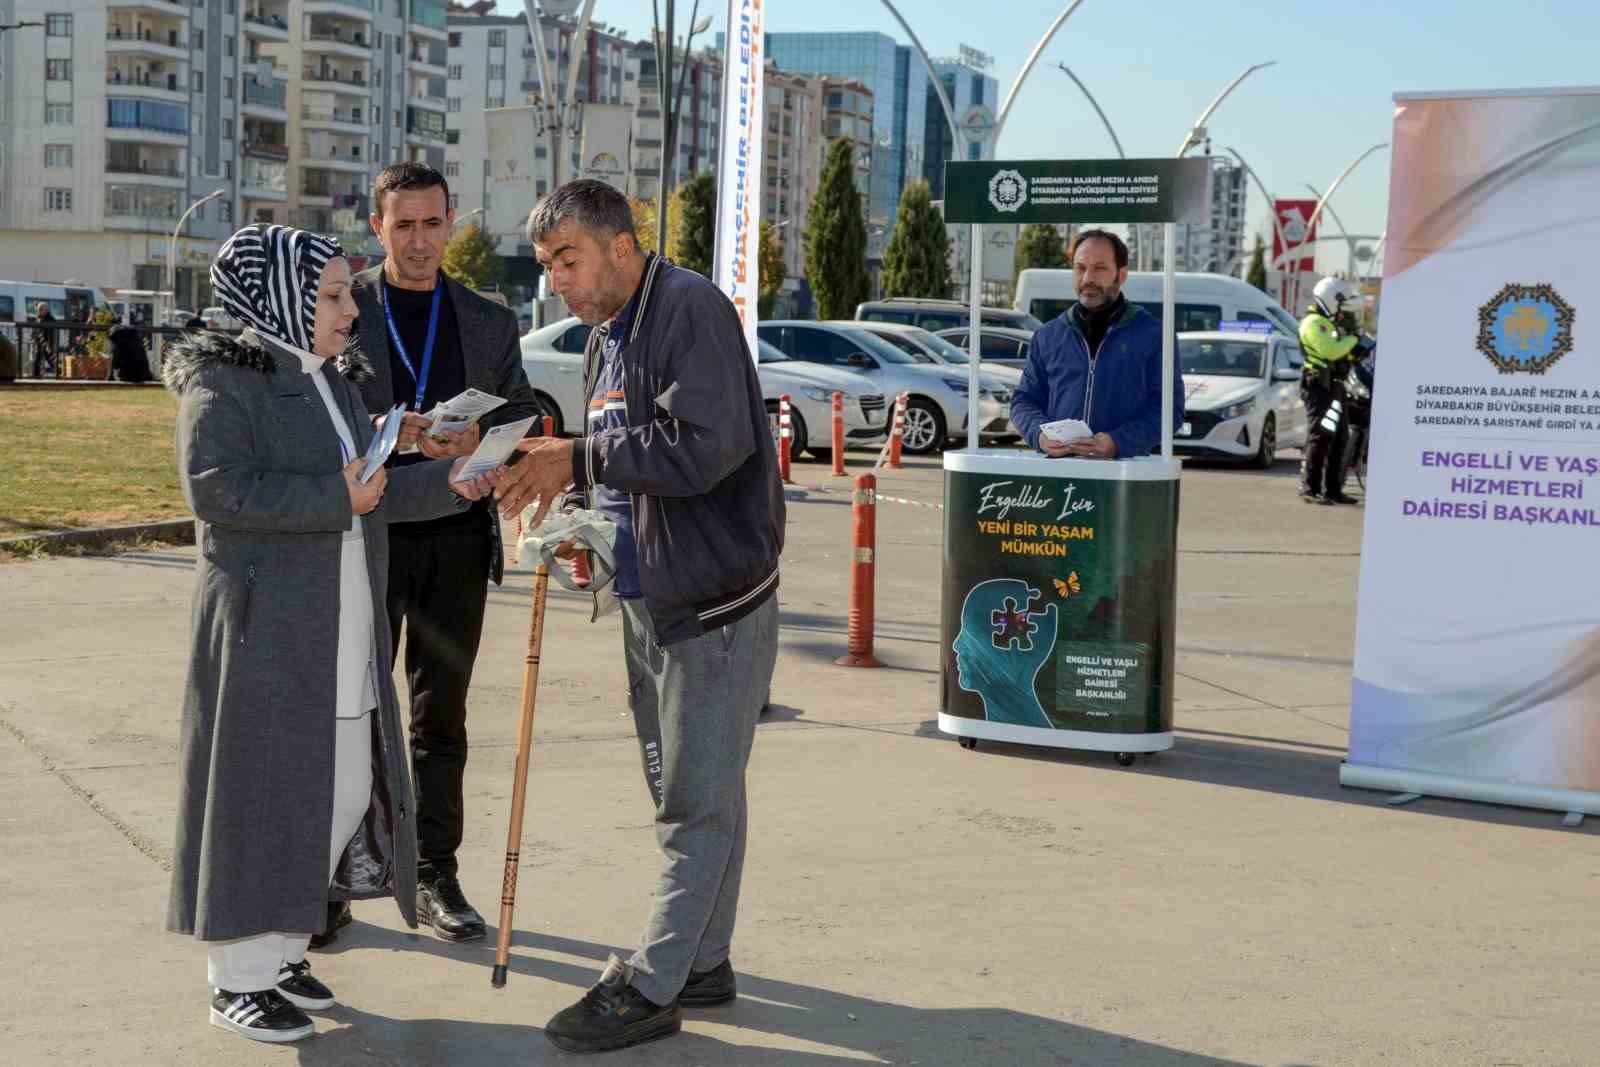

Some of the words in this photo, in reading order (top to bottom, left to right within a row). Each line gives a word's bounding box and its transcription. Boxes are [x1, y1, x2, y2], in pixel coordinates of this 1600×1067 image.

[1490, 386, 1537, 398] BAJARÊ
[1539, 388, 1577, 399] MEZIN
[1580, 389, 1589, 399] A
[1416, 399, 1484, 411] DİYARBAKIR
[1487, 400, 1561, 414] BÜYÜKŞEHİR
[1579, 420, 1593, 430] YA
[1421, 450, 1512, 470] ENGELLİ
[1519, 455, 1549, 471] VE
[1555, 456, 1600, 477] YAŞ
[1450, 474, 1583, 499] HİZMETLERİ
[977, 480, 1053, 520] Engelliler
[1056, 483, 1095, 521] İçin
[1402, 497, 1487, 520] DAİRESİ
[977, 520, 1010, 535] YENİ
[1014, 521, 1037, 536] BİR
[1040, 524, 1094, 540] YAŞAM
[1001, 539, 1066, 556] MÜMKÜN
[1066, 655, 1100, 665] ENGELLİ
[1101, 657, 1112, 666] VE
[1113, 658, 1138, 668] YAŞLI
[1077, 666, 1126, 678] HİZMETLERİ
[1085, 677, 1118, 688] DAİRESİ
[1076, 688, 1126, 699] BAŞKANLIĞI
[645, 742, 660, 773] CLUB
